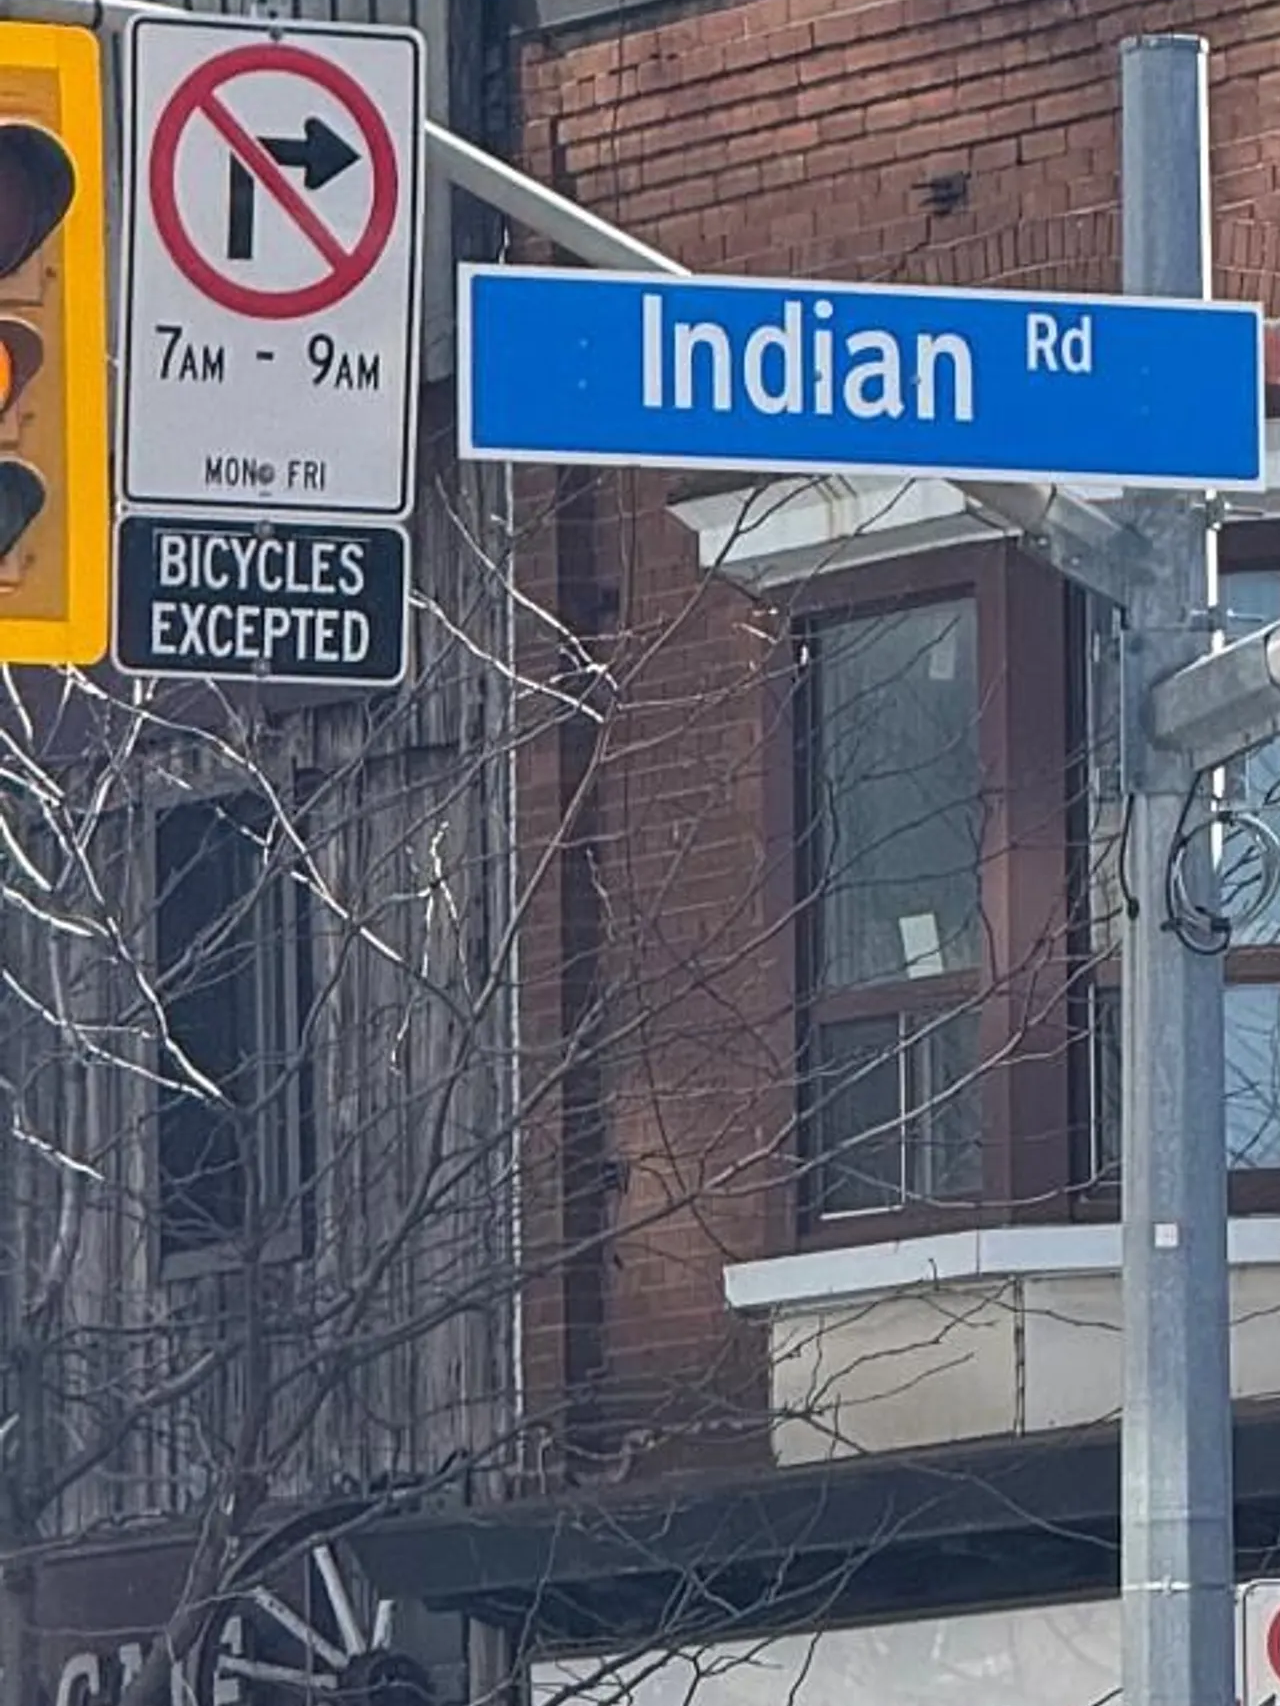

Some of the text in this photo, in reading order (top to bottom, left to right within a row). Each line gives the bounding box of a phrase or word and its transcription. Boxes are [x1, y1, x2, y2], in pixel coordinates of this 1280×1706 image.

[155, 324, 225, 384] 7AM
[307, 332, 381, 390] 9AM
[642, 294, 1094, 423] Indian Rd
[205, 453, 327, 492] MON FRI
[160, 535, 365, 593] BICYCLES
[151, 606, 371, 663] EXCEPTED
